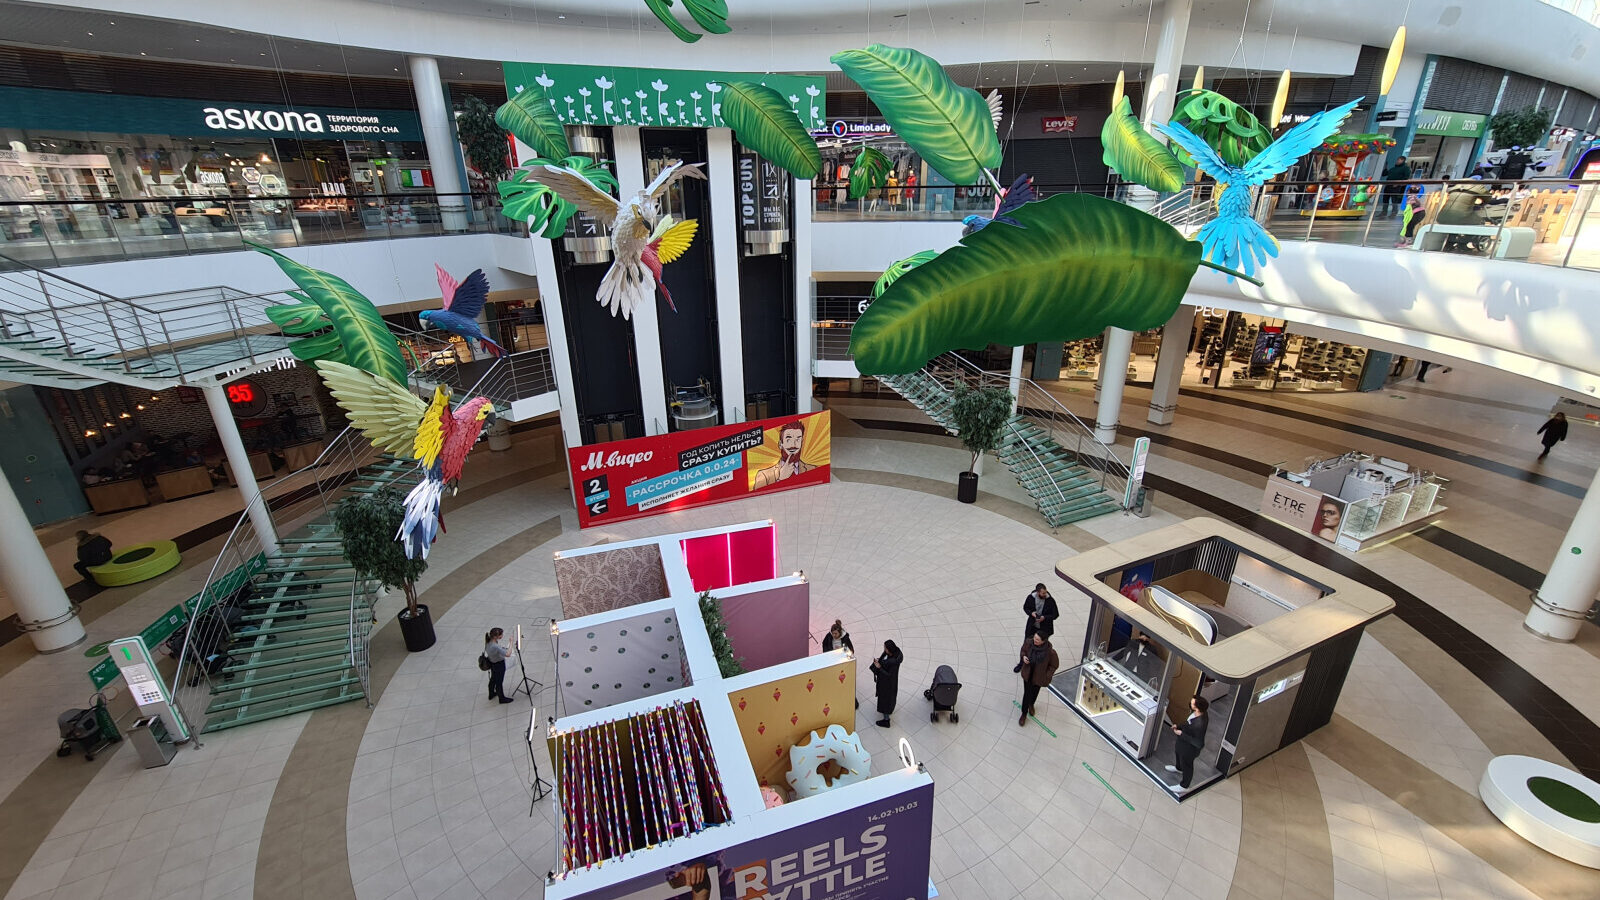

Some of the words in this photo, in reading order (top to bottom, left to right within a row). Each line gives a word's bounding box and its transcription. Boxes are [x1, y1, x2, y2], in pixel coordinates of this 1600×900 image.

[203, 107, 324, 133] askona
[326, 114, 379, 124] ТЕРРИТОРИЯ
[329, 124, 380, 133] ЗДОРОВОГО
[382, 126, 400, 134] СНА
[850, 123, 891, 133] LimoLady
[228, 384, 253, 403] 85
[681, 450, 698, 460] ГОД
[698, 440, 730, 453] КОПИТЬ
[731, 429, 761, 443] НЕЛЬЗЯ
[682, 451, 715, 468] СРАЗУ
[717, 436, 762, 457] КУПИТЬ?
[589, 479, 602, 494] 2
[632, 469, 702, 498] РАССРОЧКА
[641, 491, 680, 508] ИСПОЛНЯЕТ
[680, 481, 711, 494] ЖЕЛАНИЯ
[711, 474, 731, 484] СРАЗУ
[734, 824, 887, 898] REELS
